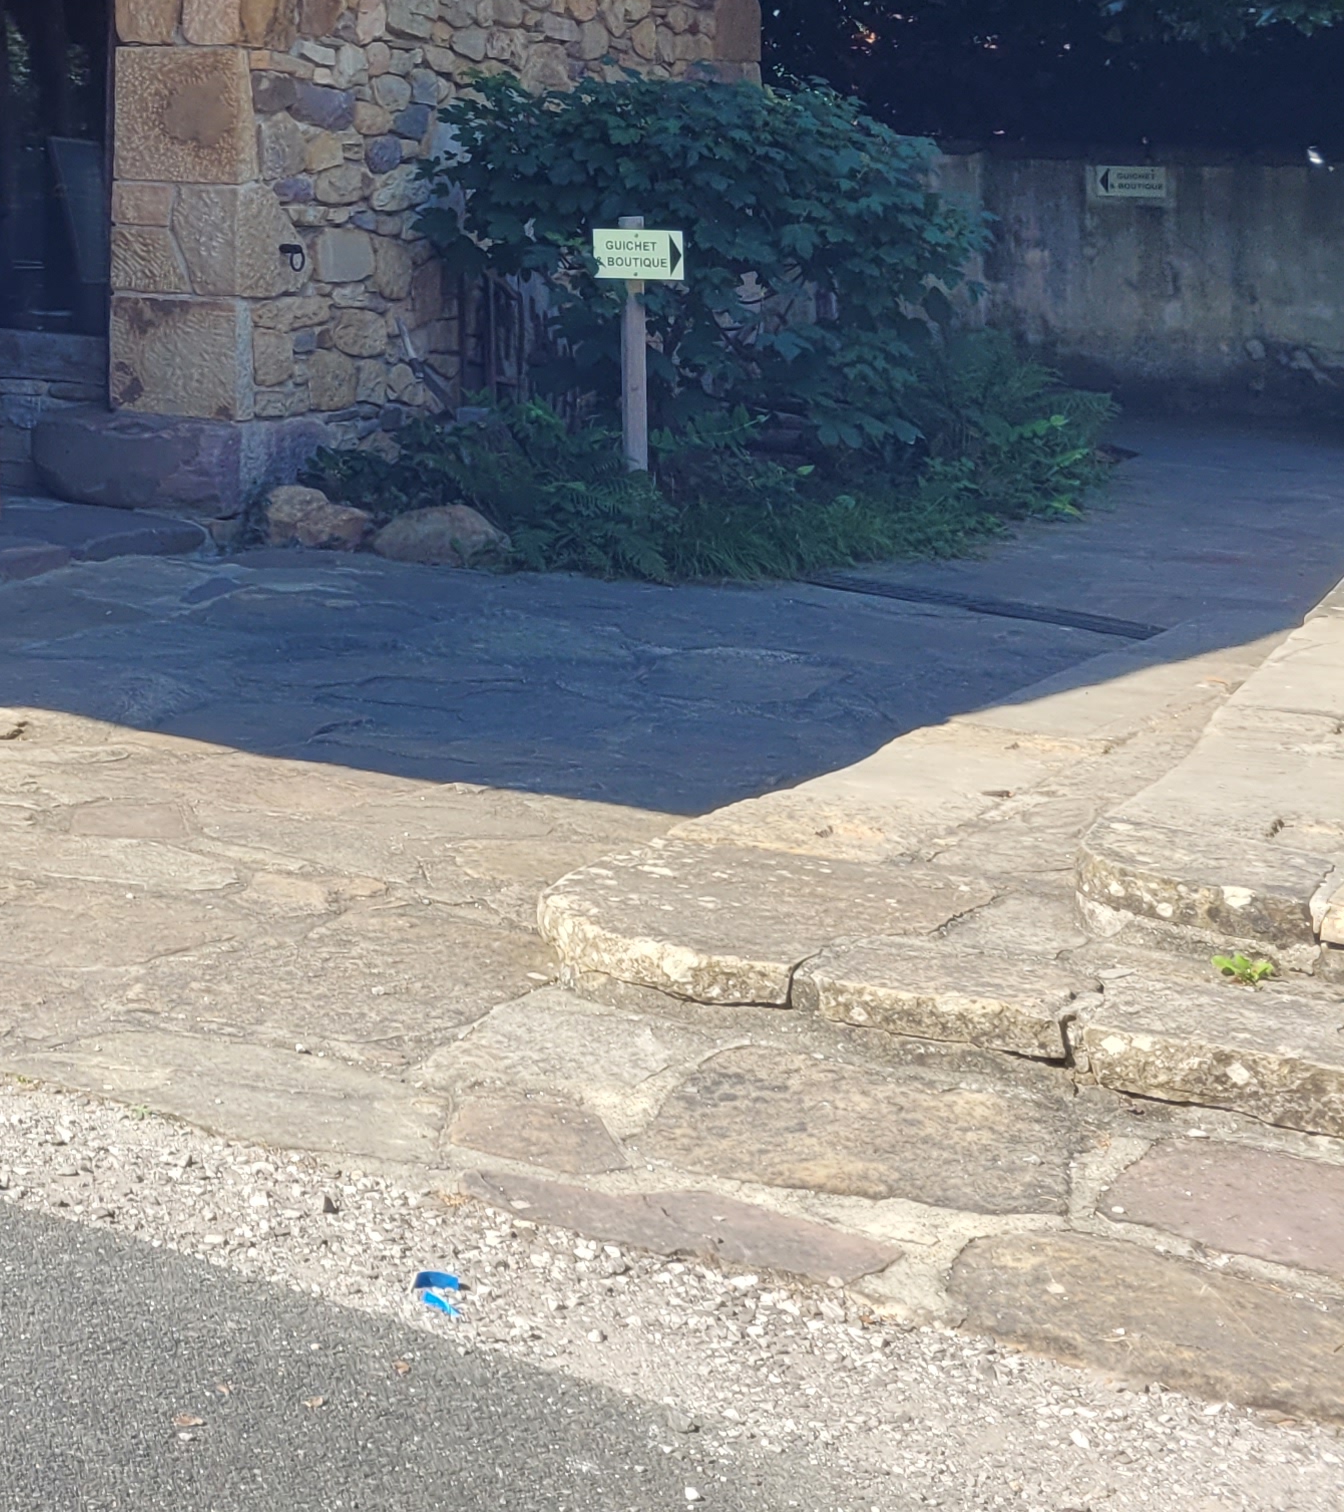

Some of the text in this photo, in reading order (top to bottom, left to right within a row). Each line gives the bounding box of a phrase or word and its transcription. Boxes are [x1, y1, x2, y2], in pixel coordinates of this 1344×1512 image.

[1116, 172, 1156, 181] GUICHET
[605, 240, 657, 251] GUICHET
[607, 256, 668, 268] BOUTIQUE
